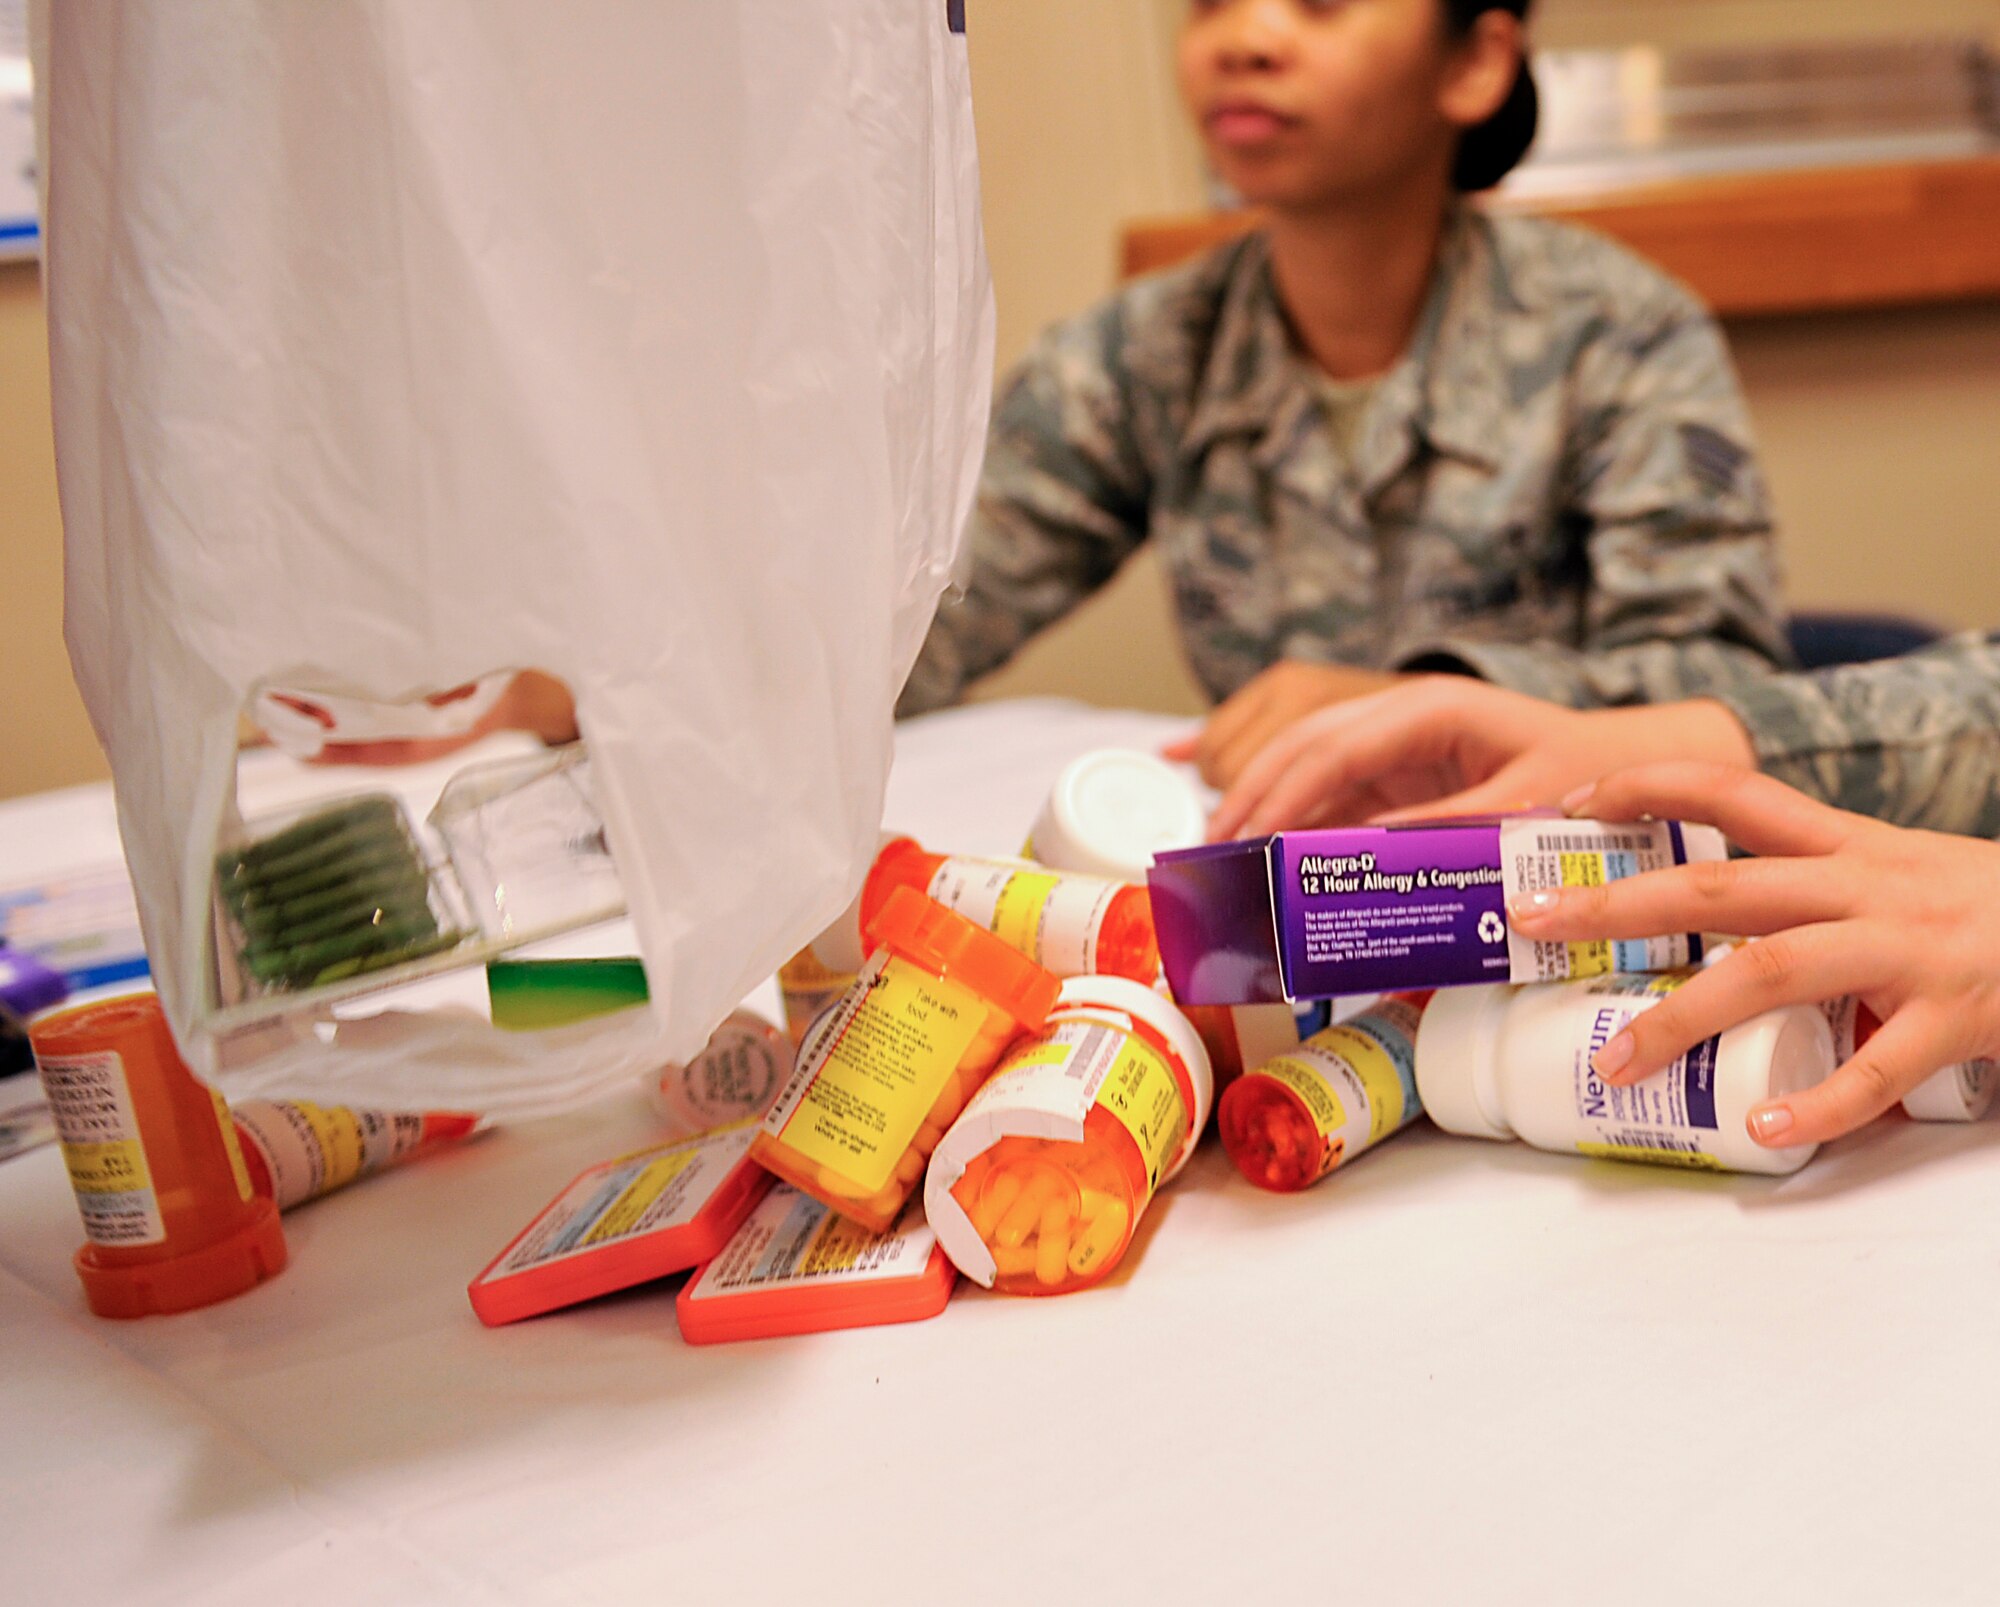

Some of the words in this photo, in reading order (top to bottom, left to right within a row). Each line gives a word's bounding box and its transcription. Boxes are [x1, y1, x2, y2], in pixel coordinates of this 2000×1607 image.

[1302, 877, 1319, 894] 12
[1324, 874, 1359, 893] Hour
[1363, 872, 1413, 893] Allergy
[1416, 869, 1427, 888] &
[1431, 866, 1503, 889] Congestion
[1584, 1008, 1615, 1118] Nexum
